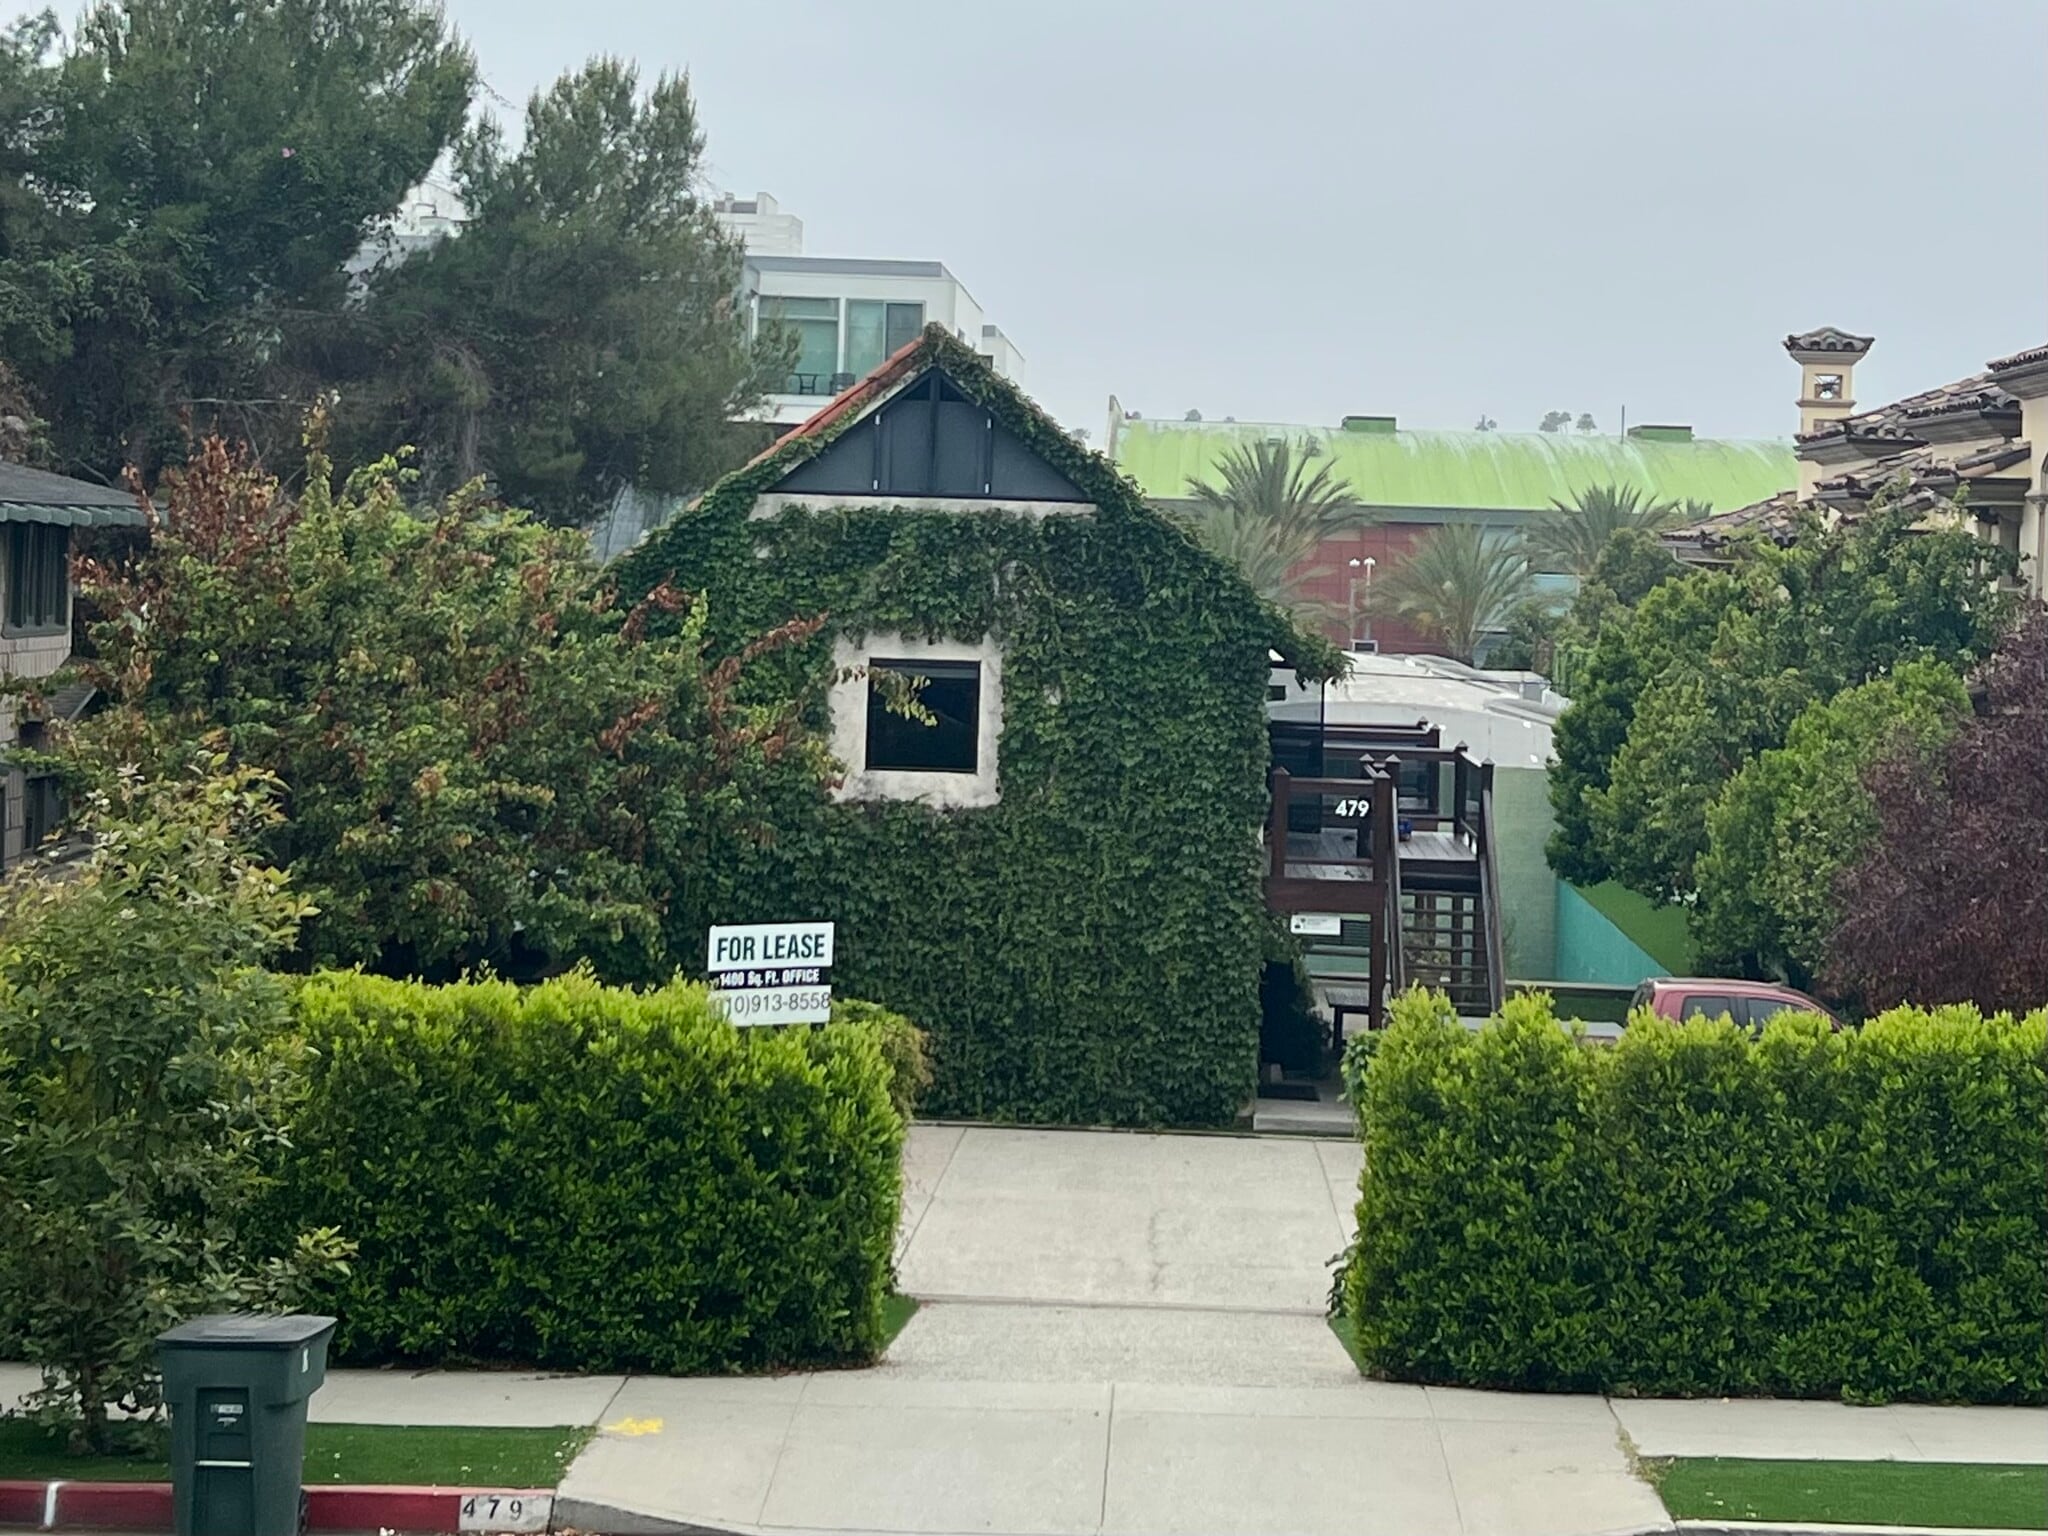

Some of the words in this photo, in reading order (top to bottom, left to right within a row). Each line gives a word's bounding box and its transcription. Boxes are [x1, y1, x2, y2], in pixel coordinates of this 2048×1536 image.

[1335, 799, 1370, 817] 479
[716, 935, 756, 962] FOR
[762, 933, 826, 960] LEASE
[782, 967, 820, 984] OFFICE
[720, 992, 831, 1017] 10)913-8558
[463, 1498, 522, 1521] 479
